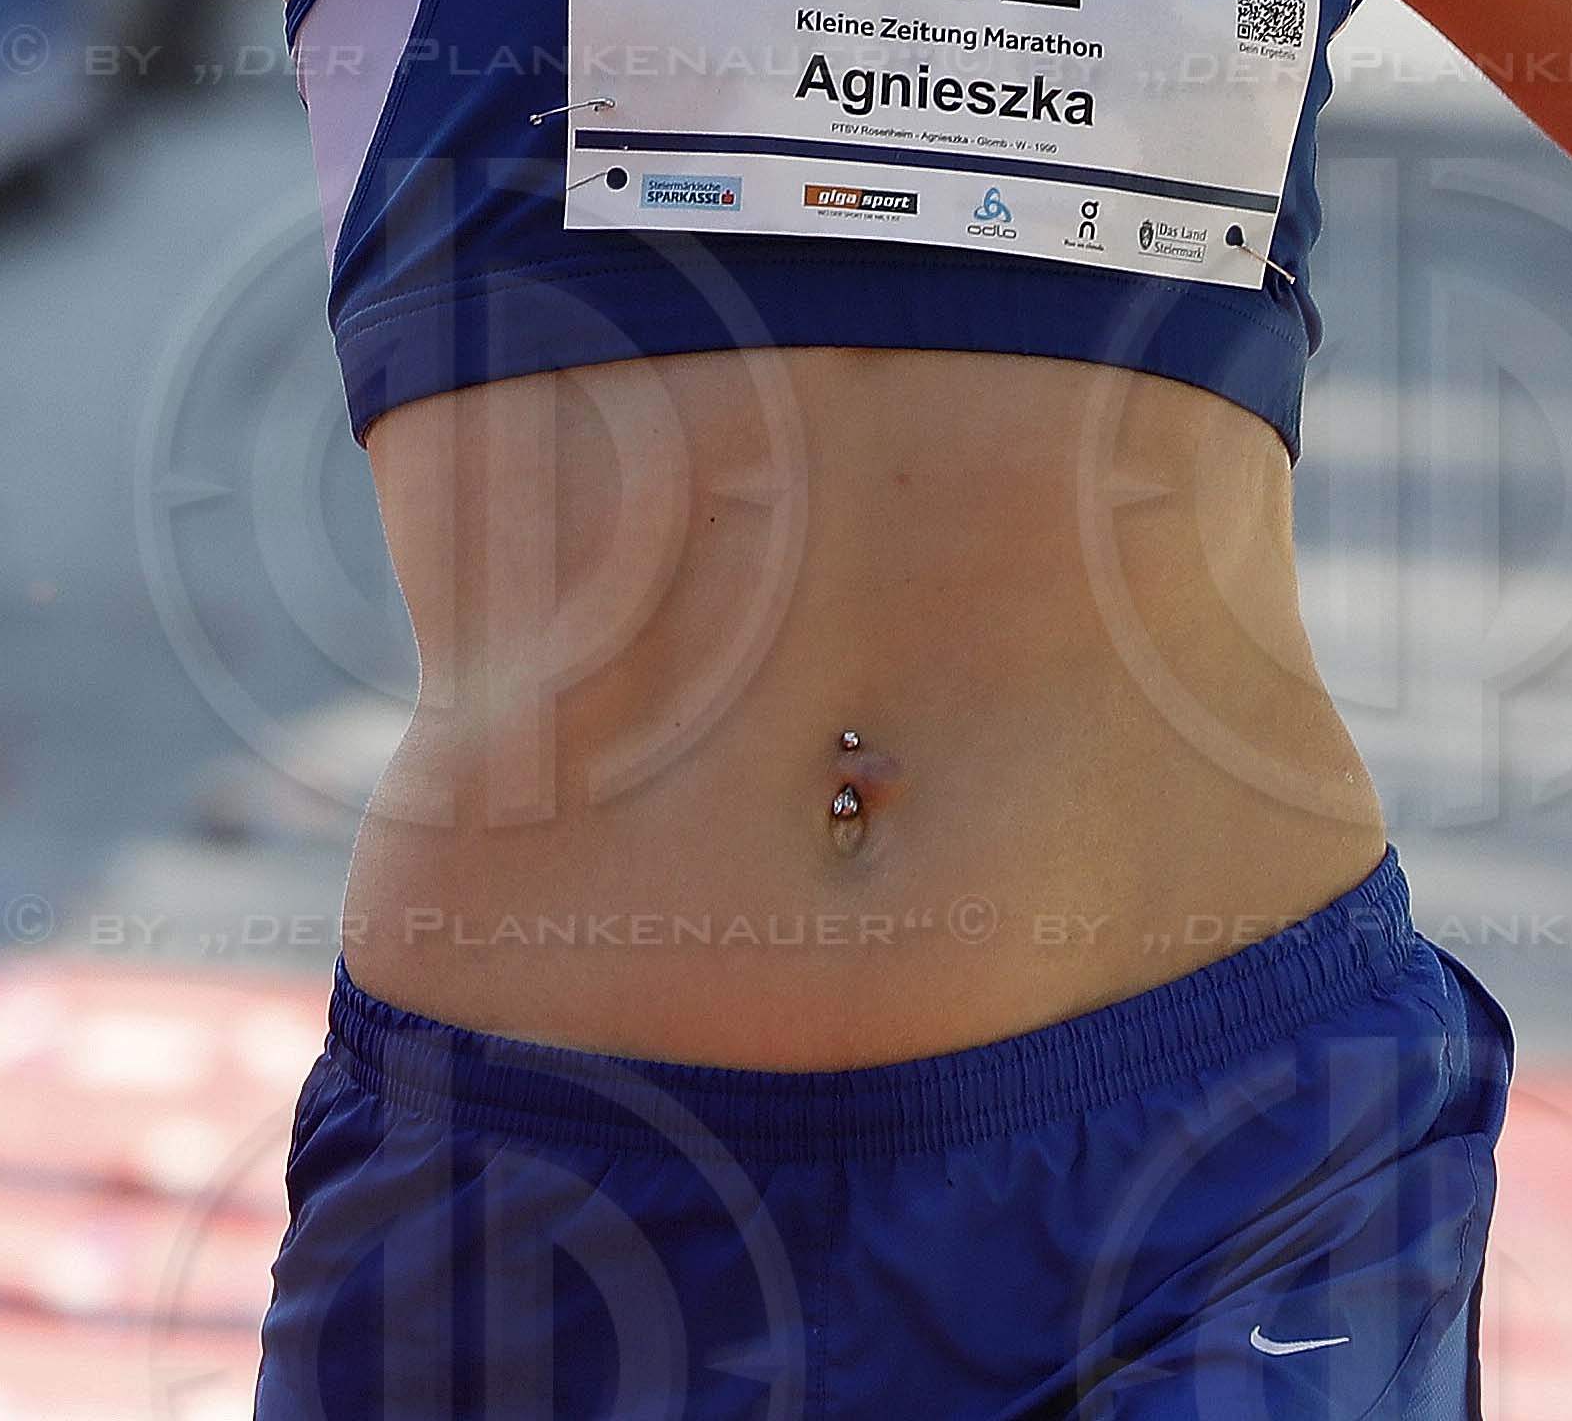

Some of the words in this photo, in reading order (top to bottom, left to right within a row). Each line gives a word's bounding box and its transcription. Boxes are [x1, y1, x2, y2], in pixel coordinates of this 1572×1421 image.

[796, 10, 875, 37] Kleine
[879, 17, 978, 50] Zeitung
[983, 26, 1104, 59] Marathon
[794, 53, 1095, 126] Agnieszka
[647, 190, 720, 205] SPARKASSE
[967, 223, 1017, 240] odlo
[1158, 222, 1178, 238] Das
[1181, 226, 1208, 242] Land
